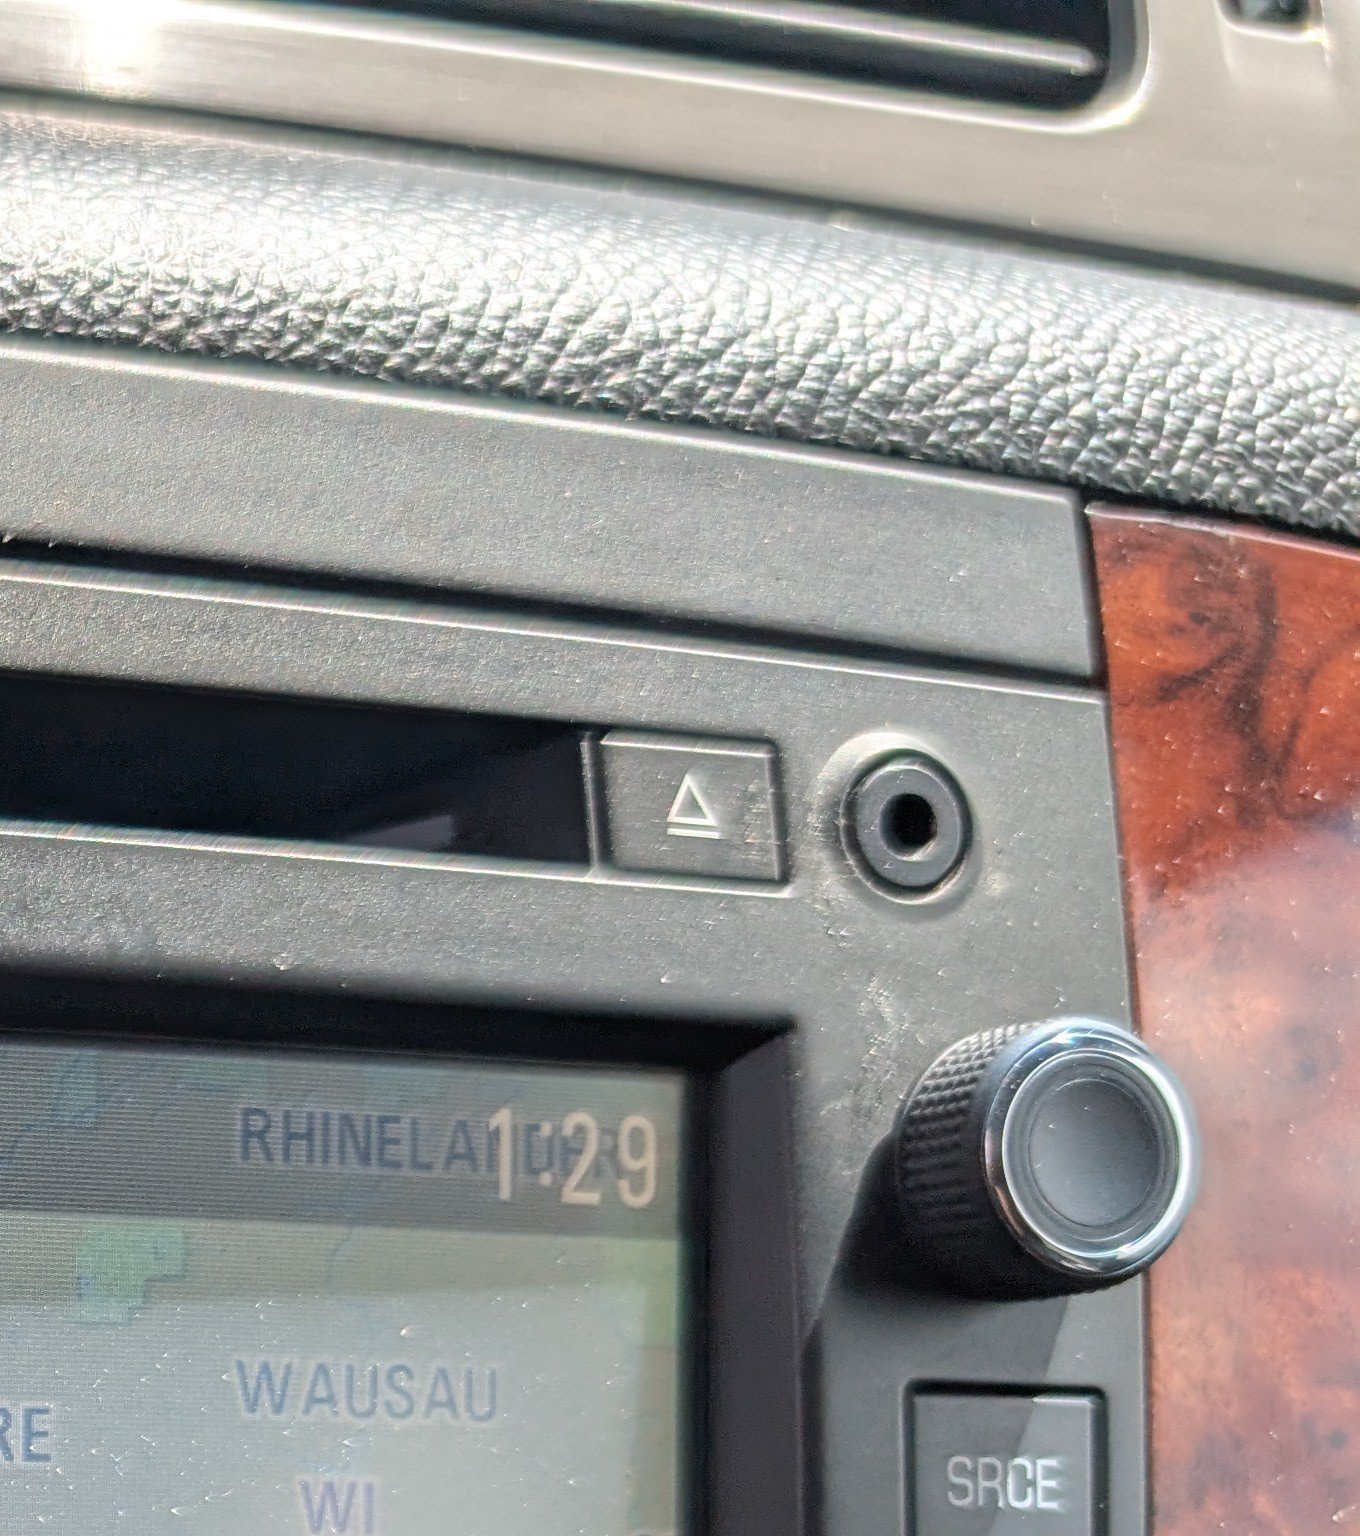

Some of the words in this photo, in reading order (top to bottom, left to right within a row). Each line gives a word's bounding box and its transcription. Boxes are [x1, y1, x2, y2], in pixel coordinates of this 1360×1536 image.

[489, 1108, 658, 1208] 1:29
[235, 1359, 498, 1422] WAUSAU
[300, 1481, 375, 1536] WI
[947, 1455, 1060, 1510] SRCE
